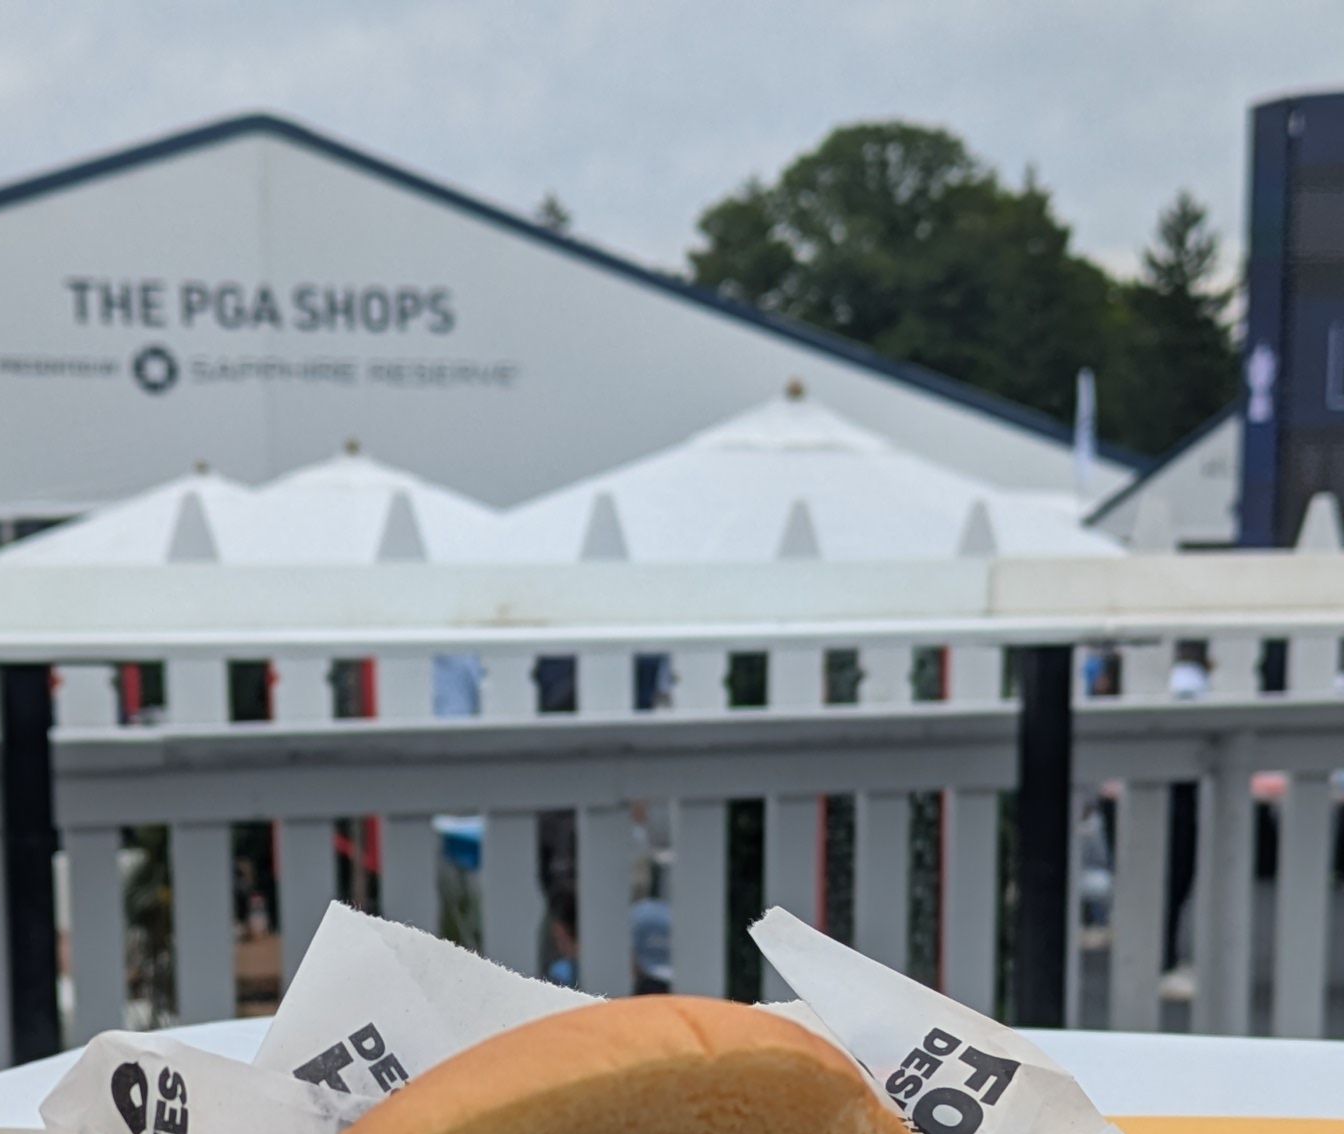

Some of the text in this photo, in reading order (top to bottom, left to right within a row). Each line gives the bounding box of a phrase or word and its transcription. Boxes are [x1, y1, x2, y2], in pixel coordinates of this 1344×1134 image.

[67, 279, 455, 335] THE PGA SHOPS
[886, 1027, 962, 1111] DES
